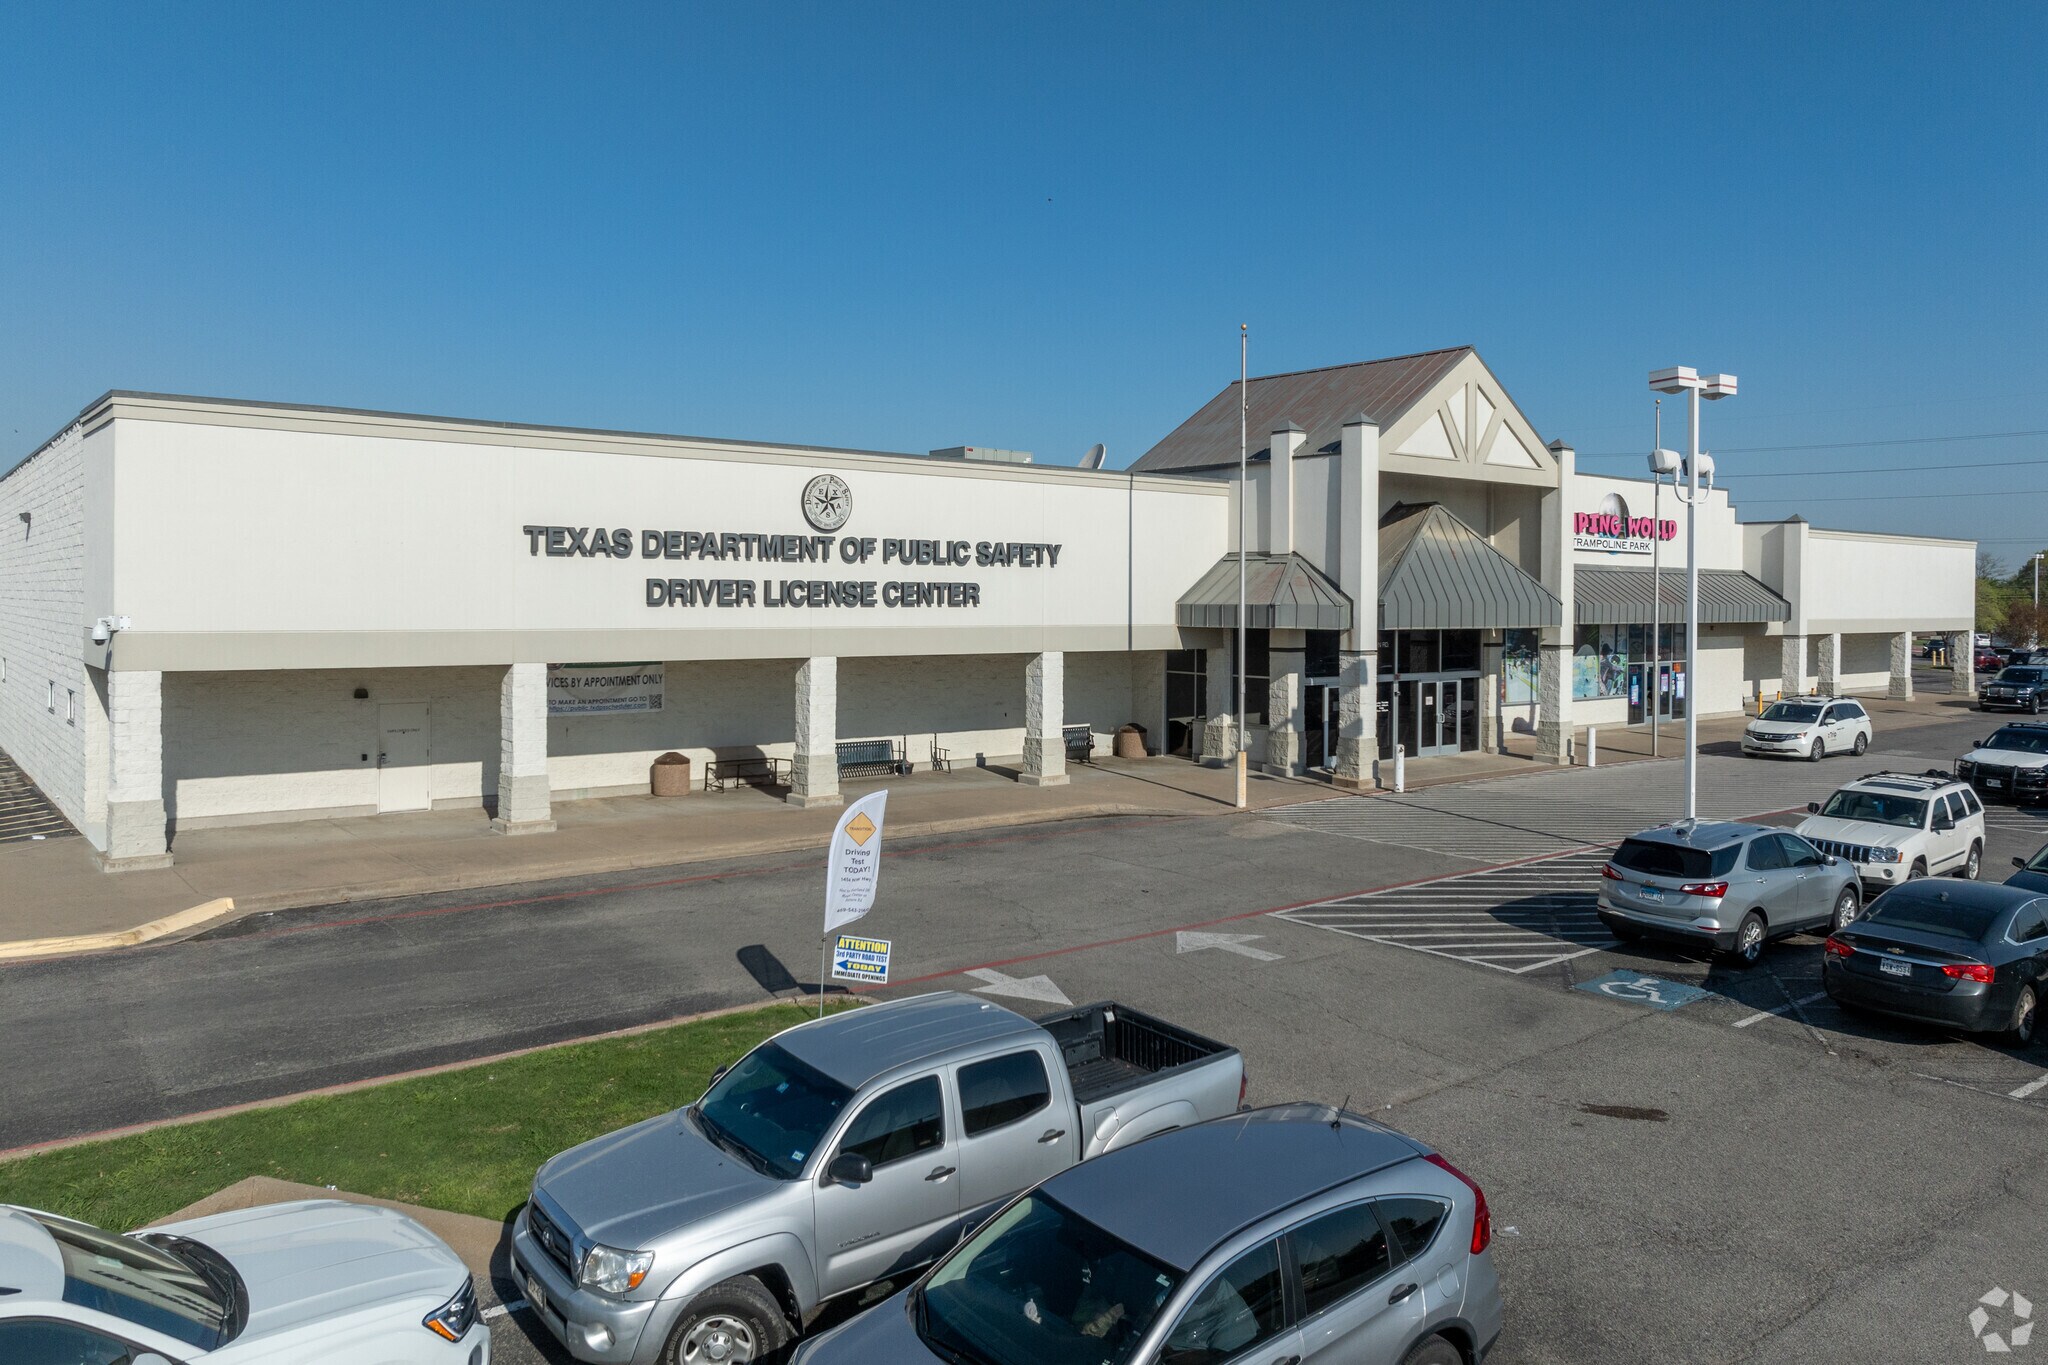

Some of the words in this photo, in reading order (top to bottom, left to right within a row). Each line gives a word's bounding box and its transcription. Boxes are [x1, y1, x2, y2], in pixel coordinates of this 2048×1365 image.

[523, 525, 633, 558] TEXAS
[642, 529, 836, 563] DEPARTMENT
[840, 536, 877, 564] OF
[882, 538, 971, 567] PUBLIC
[975, 541, 1062, 568] SAFETY
[1629, 542, 1651, 551] PARK
[646, 578, 757, 608] DRIVER
[763, 579, 878, 608] LICENSE
[882, 581, 981, 608] CENTER
[571, 677, 582, 688] BY
[584, 675, 641, 687] APPOINTMENT
[642, 674, 663, 685] ONLY
[851, 857, 865, 865] Test
[844, 866, 871, 874] TODAY!
[838, 937, 887, 954] ATTENTION
[846, 951, 861, 960] PARTY
[862, 953, 875, 961] ROAD
[876, 955, 887, 963] TEST
[847, 962, 882, 973] TODAY
[834, 970, 861, 978] IMMEDIATE
[862, 973, 886, 982] OPENINGS
